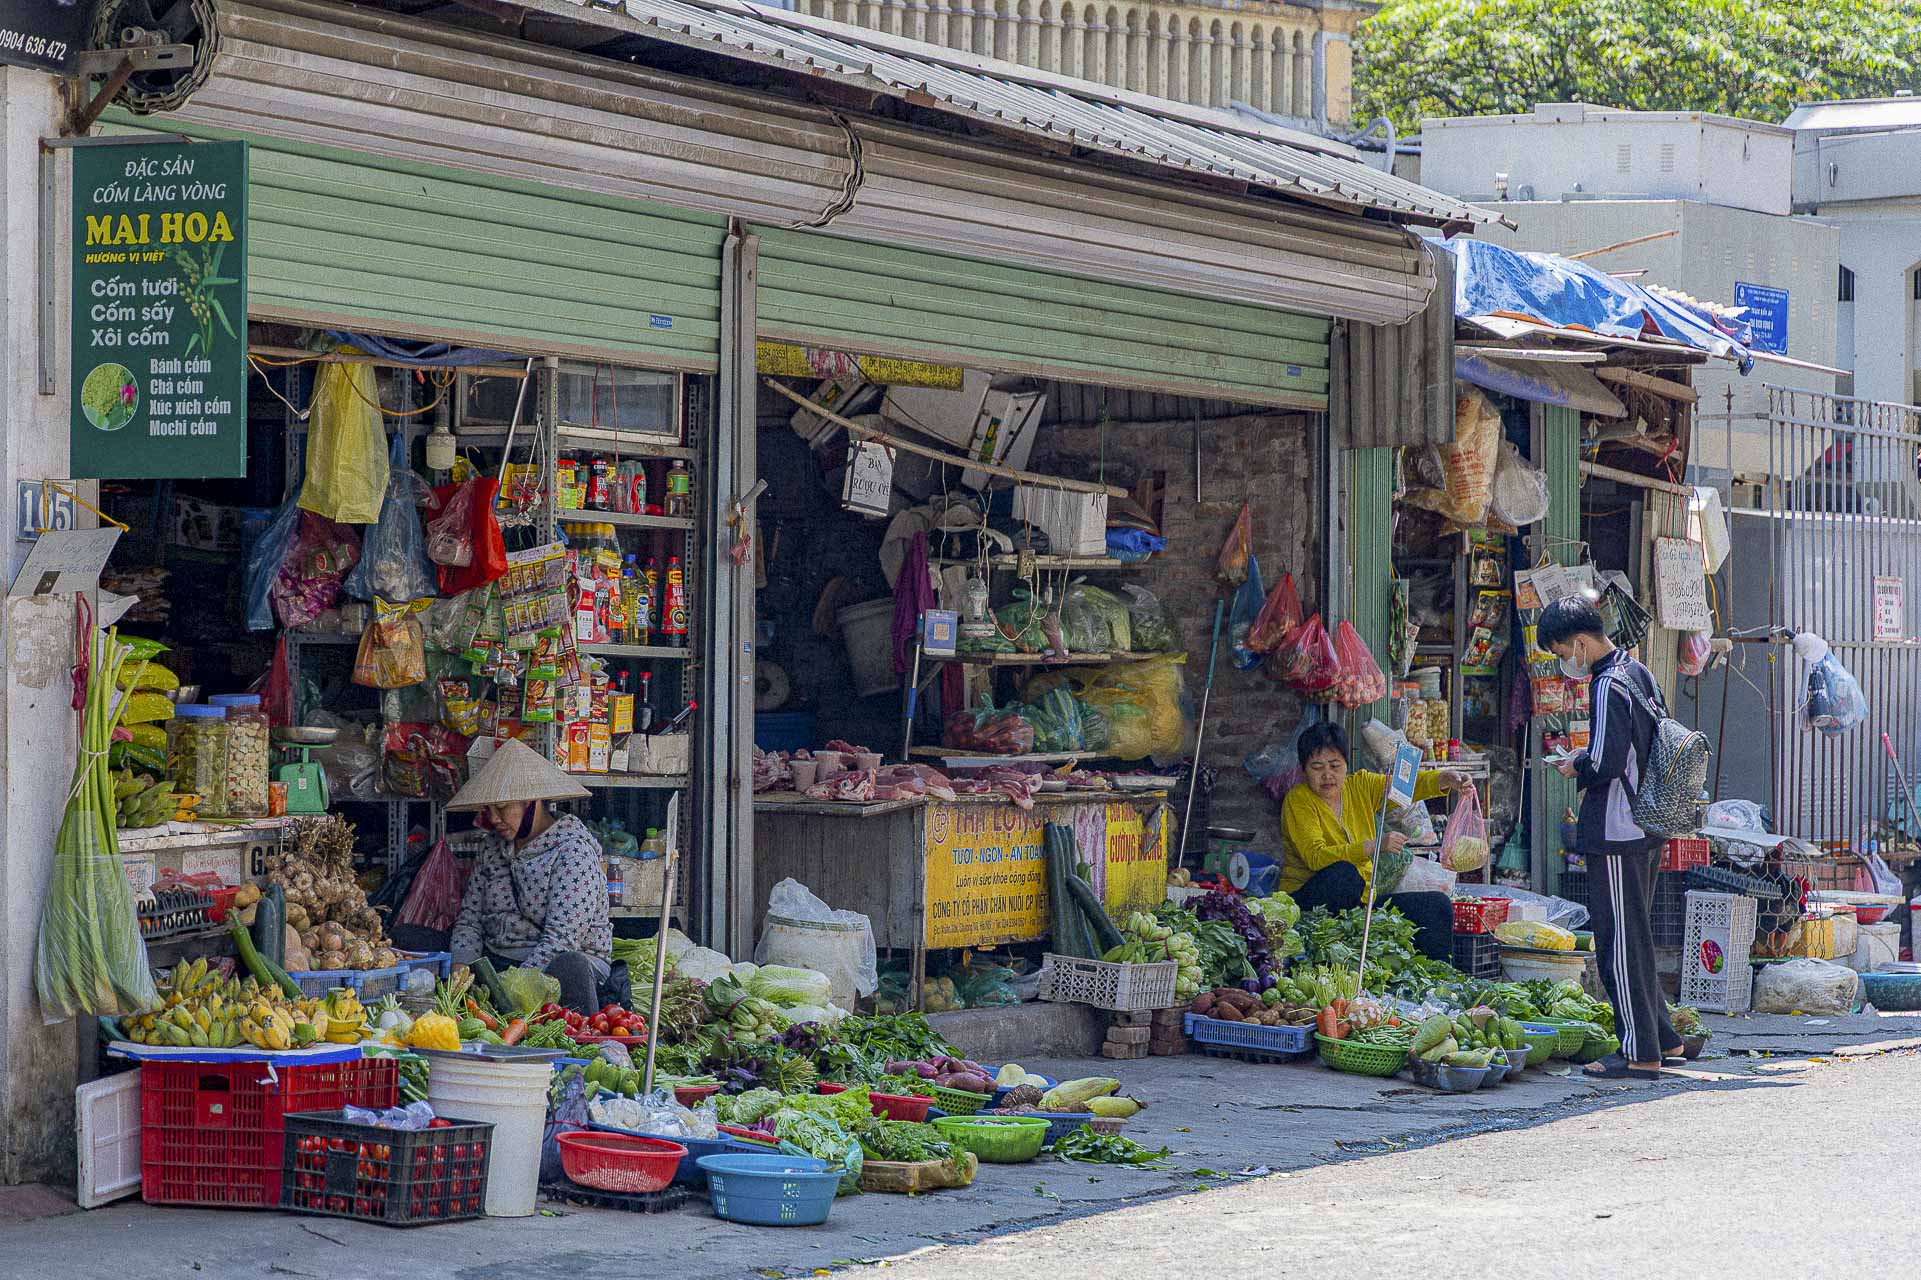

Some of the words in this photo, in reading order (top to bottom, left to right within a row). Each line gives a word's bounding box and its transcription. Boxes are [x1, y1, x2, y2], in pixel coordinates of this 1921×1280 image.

[0, 29, 24, 51] 0904
[25, 36, 46, 56] 636
[47, 41, 67, 61] 472
[125, 157, 158, 180] ĐẶC
[161, 155, 194, 176] SẢN
[93, 181, 129, 203] CỐM
[134, 183, 176, 202] LÀNG
[182, 181, 226, 200] VÒNG
[85, 213, 151, 246] MAI
[160, 211, 234, 244] HOA
[86, 251, 126, 263] HƯƠNG
[129, 252, 140, 264] VỊ
[142, 250, 165, 264] VIỆT
[91, 275, 136, 297] Cốm
[142, 278, 178, 296] tươi
[91, 300, 136, 321] Cốm
[141, 299, 175, 324] sấy
[90, 328, 121, 347] Xôi
[127, 325, 170, 346] cốm
[150, 358, 181, 374] Bánh
[184, 355, 211, 373] cốm
[150, 377, 174, 395] Chả
[177, 376, 203, 394] cốm
[150, 399, 172, 415] Xúc
[175, 399, 201, 415] xích
[204, 396, 231, 414] cốm
[150, 420, 187, 436] Mochi
[190, 417, 217, 435] cốm
[953, 847, 974, 865] TƯƠI
[980, 846, 1003, 864] NGON
[1010, 845, 1023, 861] AN
[1109, 827, 1136, 863] CƯỜNG
[933, 898, 951, 919] CÔNG
[953, 900, 960, 917] TY
[962, 892, 970, 916] CỔ
[1008, 893, 1024, 912] NUÔI
